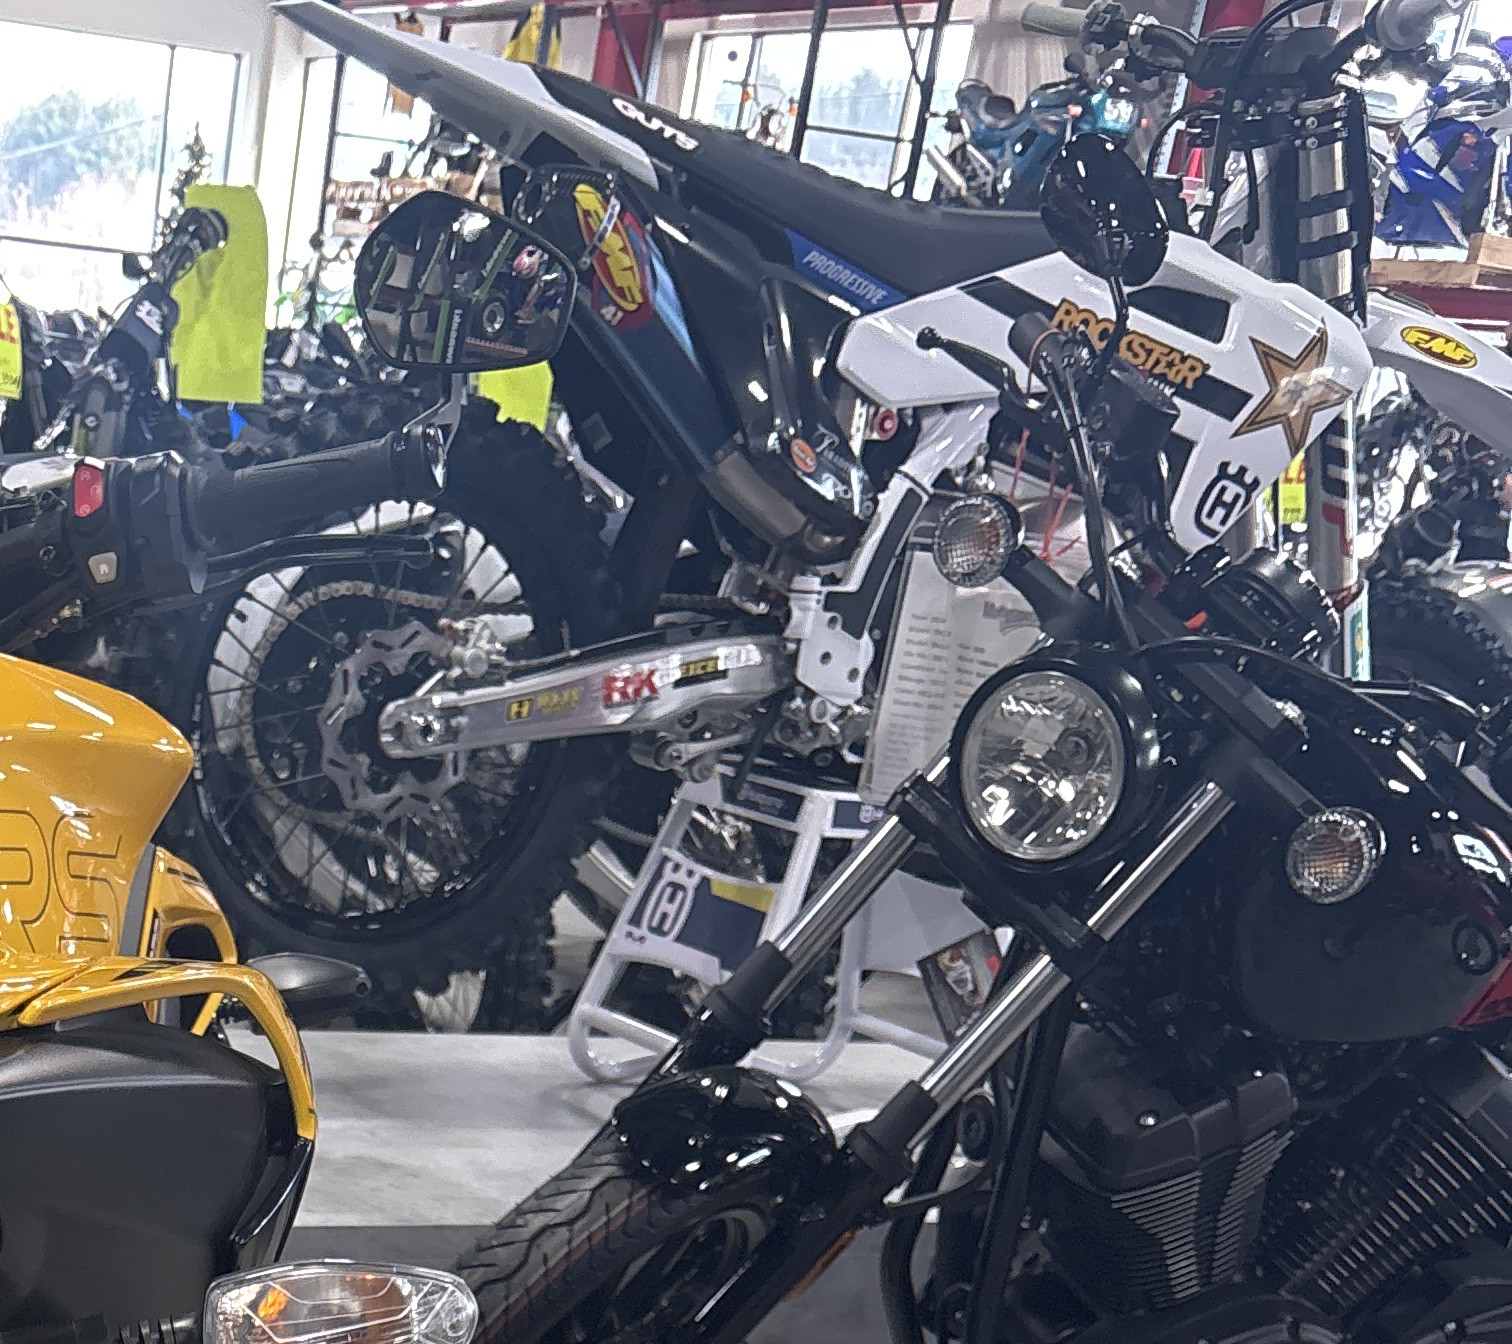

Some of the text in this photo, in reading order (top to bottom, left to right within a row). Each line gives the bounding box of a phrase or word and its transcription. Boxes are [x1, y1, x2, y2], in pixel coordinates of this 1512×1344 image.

[801, 249, 889, 306] PROGRESSIVE
[1051, 297, 1211, 390] ROCSTAR
[1402, 327, 1477, 367] FMF
